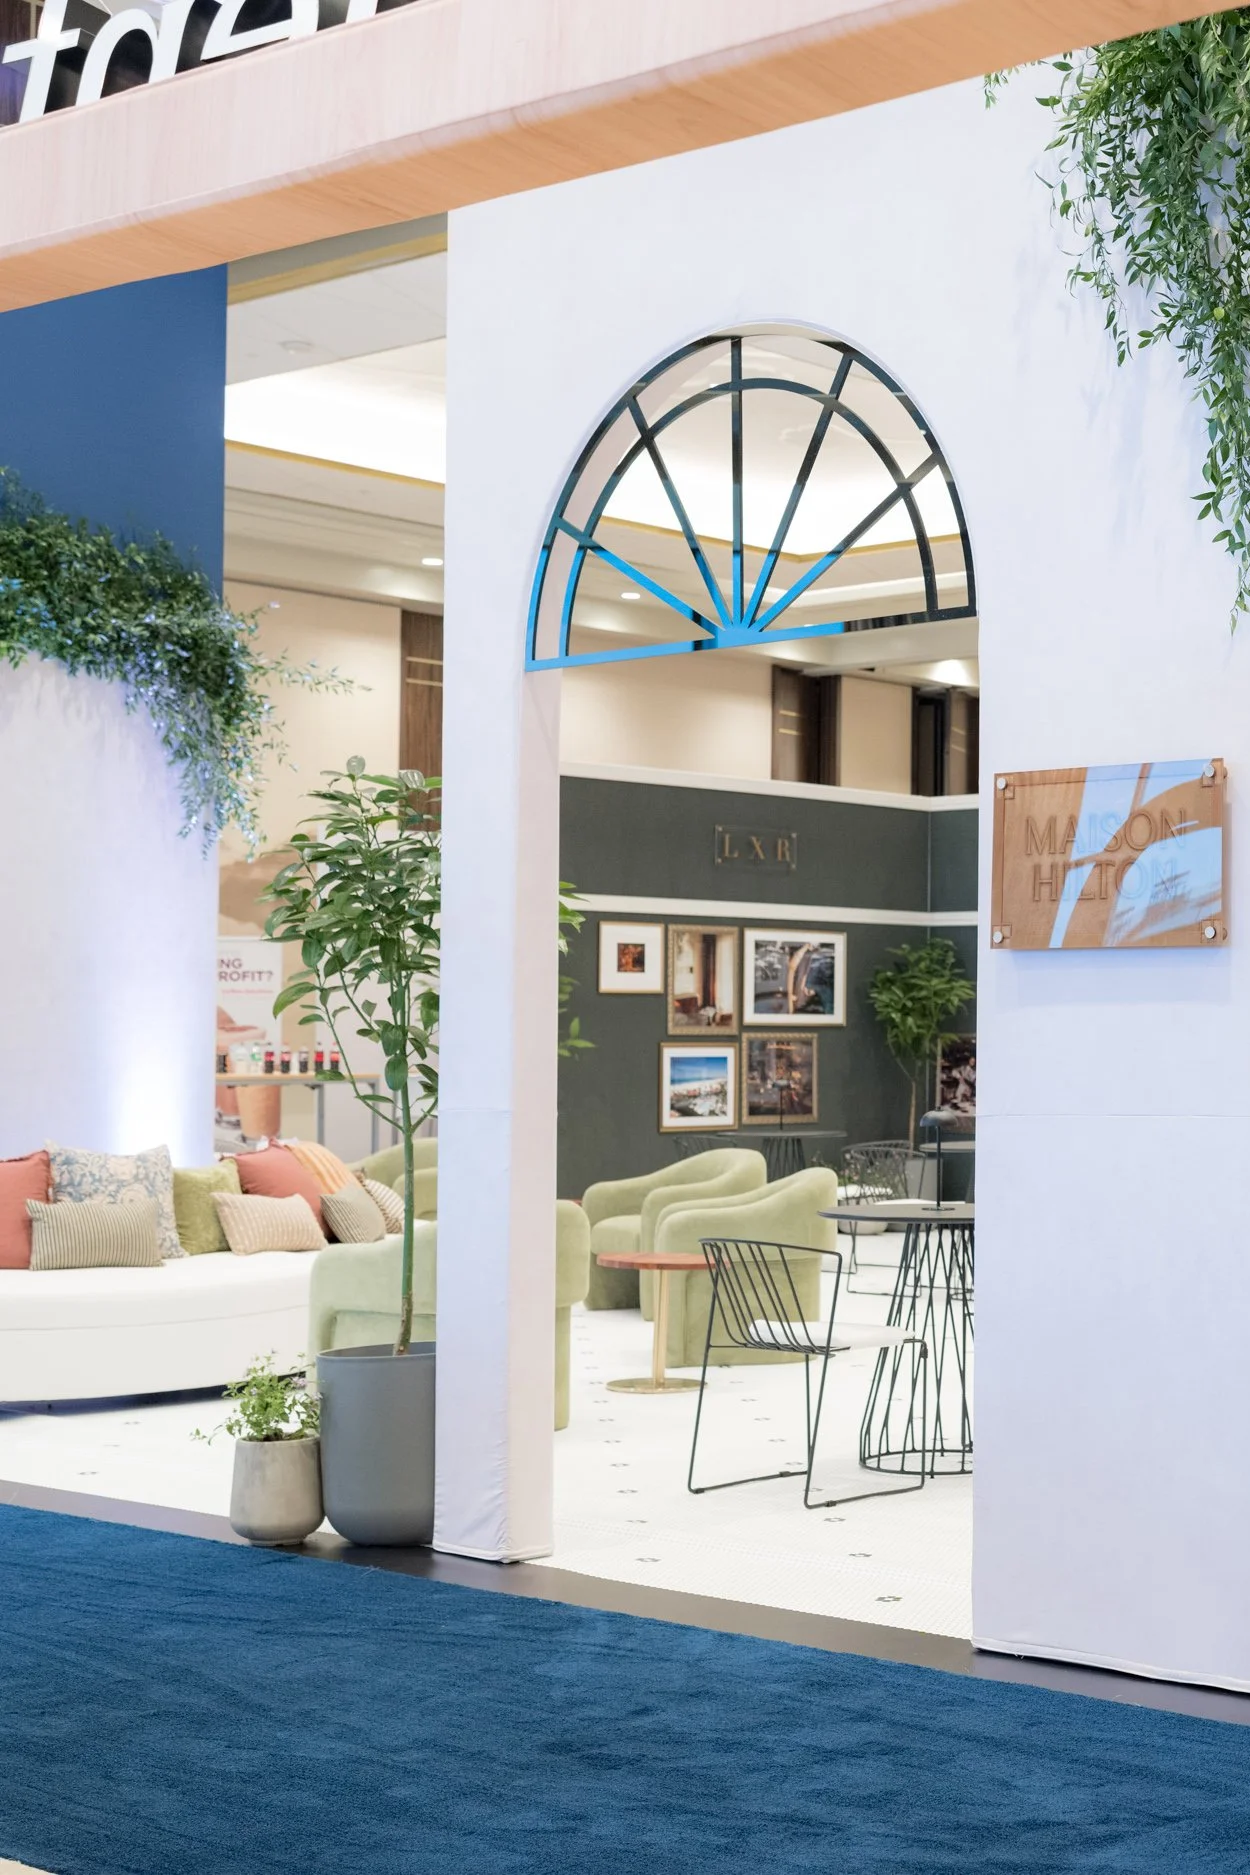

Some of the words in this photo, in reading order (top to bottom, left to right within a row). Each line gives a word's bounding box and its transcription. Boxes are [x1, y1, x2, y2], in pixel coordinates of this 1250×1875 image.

[724, 833, 792, 863] LXR
[1024, 808, 1187, 856] MAISON
[1031, 857, 1177, 902] HILTON
[218, 969, 274, 982] ROFIT?
